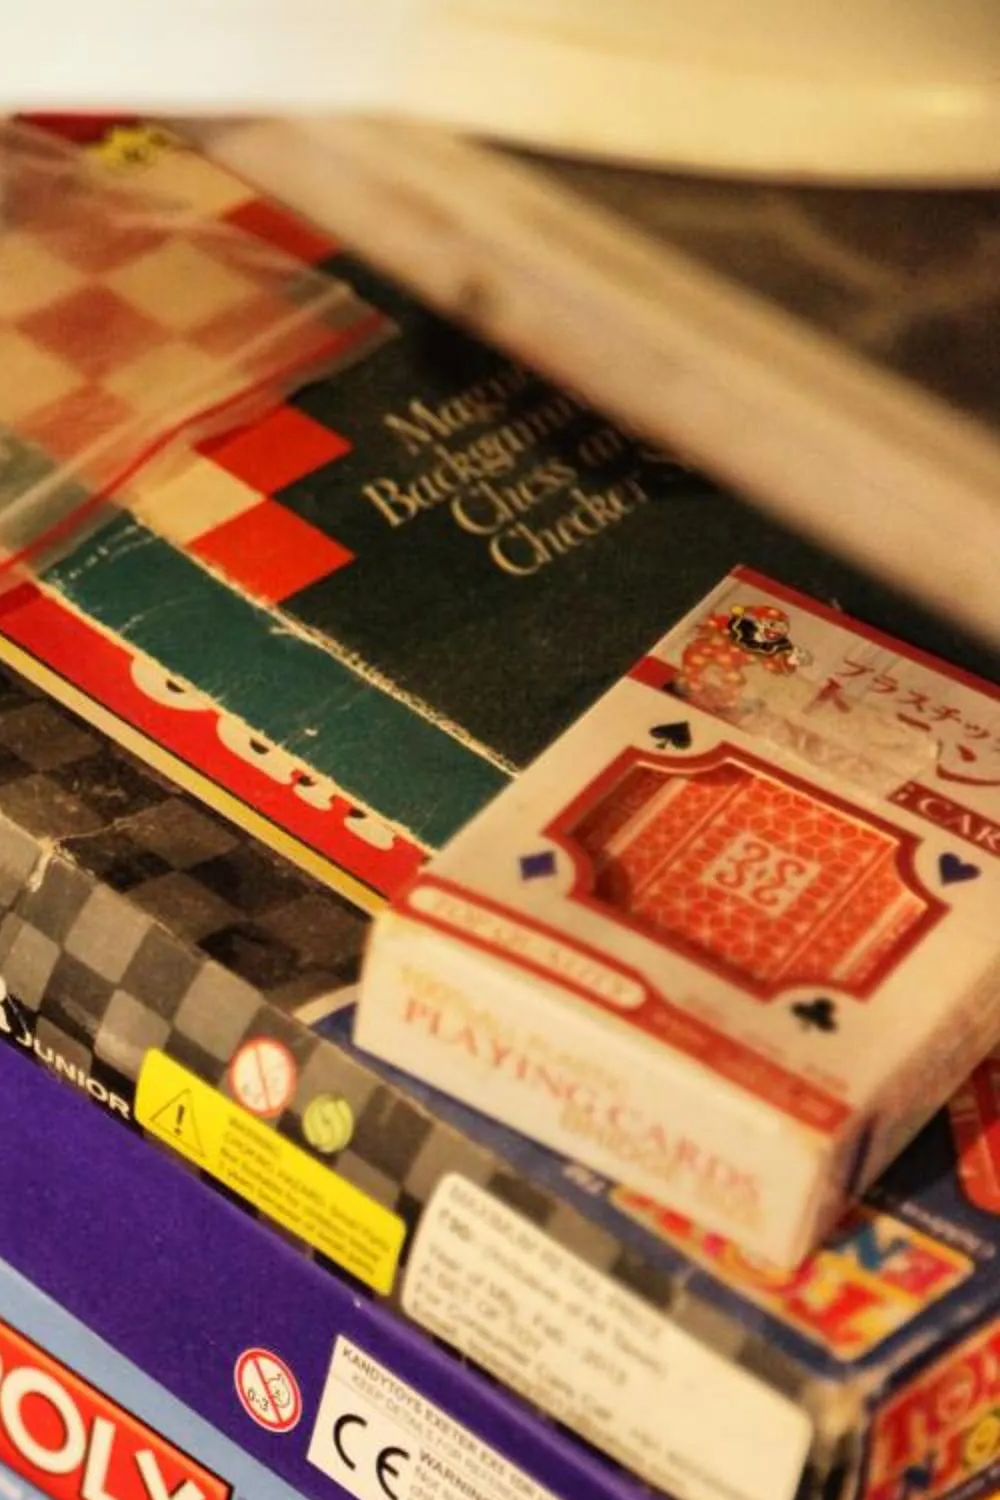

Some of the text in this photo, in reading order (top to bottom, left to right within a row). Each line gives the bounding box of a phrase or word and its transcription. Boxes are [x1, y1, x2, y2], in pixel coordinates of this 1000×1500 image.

[452, 455, 578, 535] Chess
[16, 1032, 132, 1120] JUNIOR
[400, 994, 601, 1119] PLAYING
[604, 1097, 768, 1208] CARDS
[341, 1345, 423, 1415] KANDYTOYS
[423, 1408, 477, 1455] EXETER
[412, 1464, 440, 1493] Not
